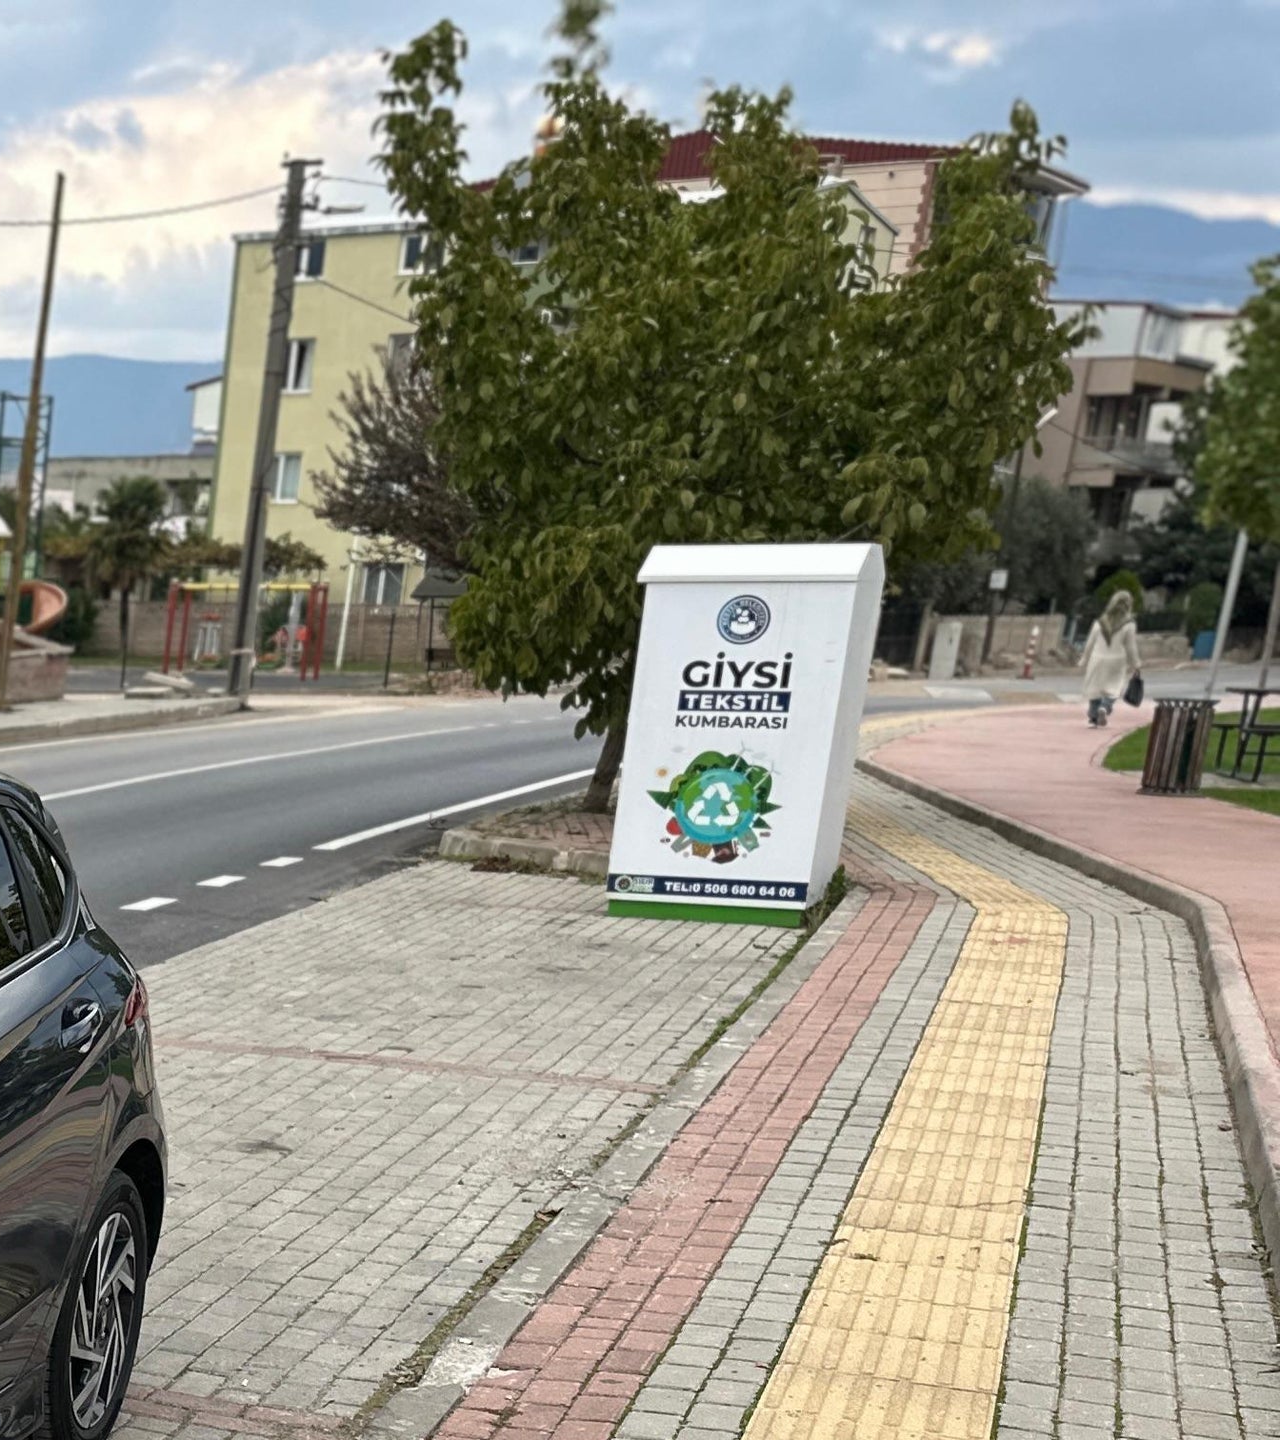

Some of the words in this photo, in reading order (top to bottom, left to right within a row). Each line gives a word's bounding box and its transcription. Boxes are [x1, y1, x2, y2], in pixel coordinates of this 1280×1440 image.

[682, 651, 793, 689] GİYSİ
[675, 715, 788, 729] KUMBARASI
[704, 883, 728, 894] 506
[731, 884, 756, 896] 680
[759, 886, 775, 897] 64
[778, 887, 796, 898] 06
